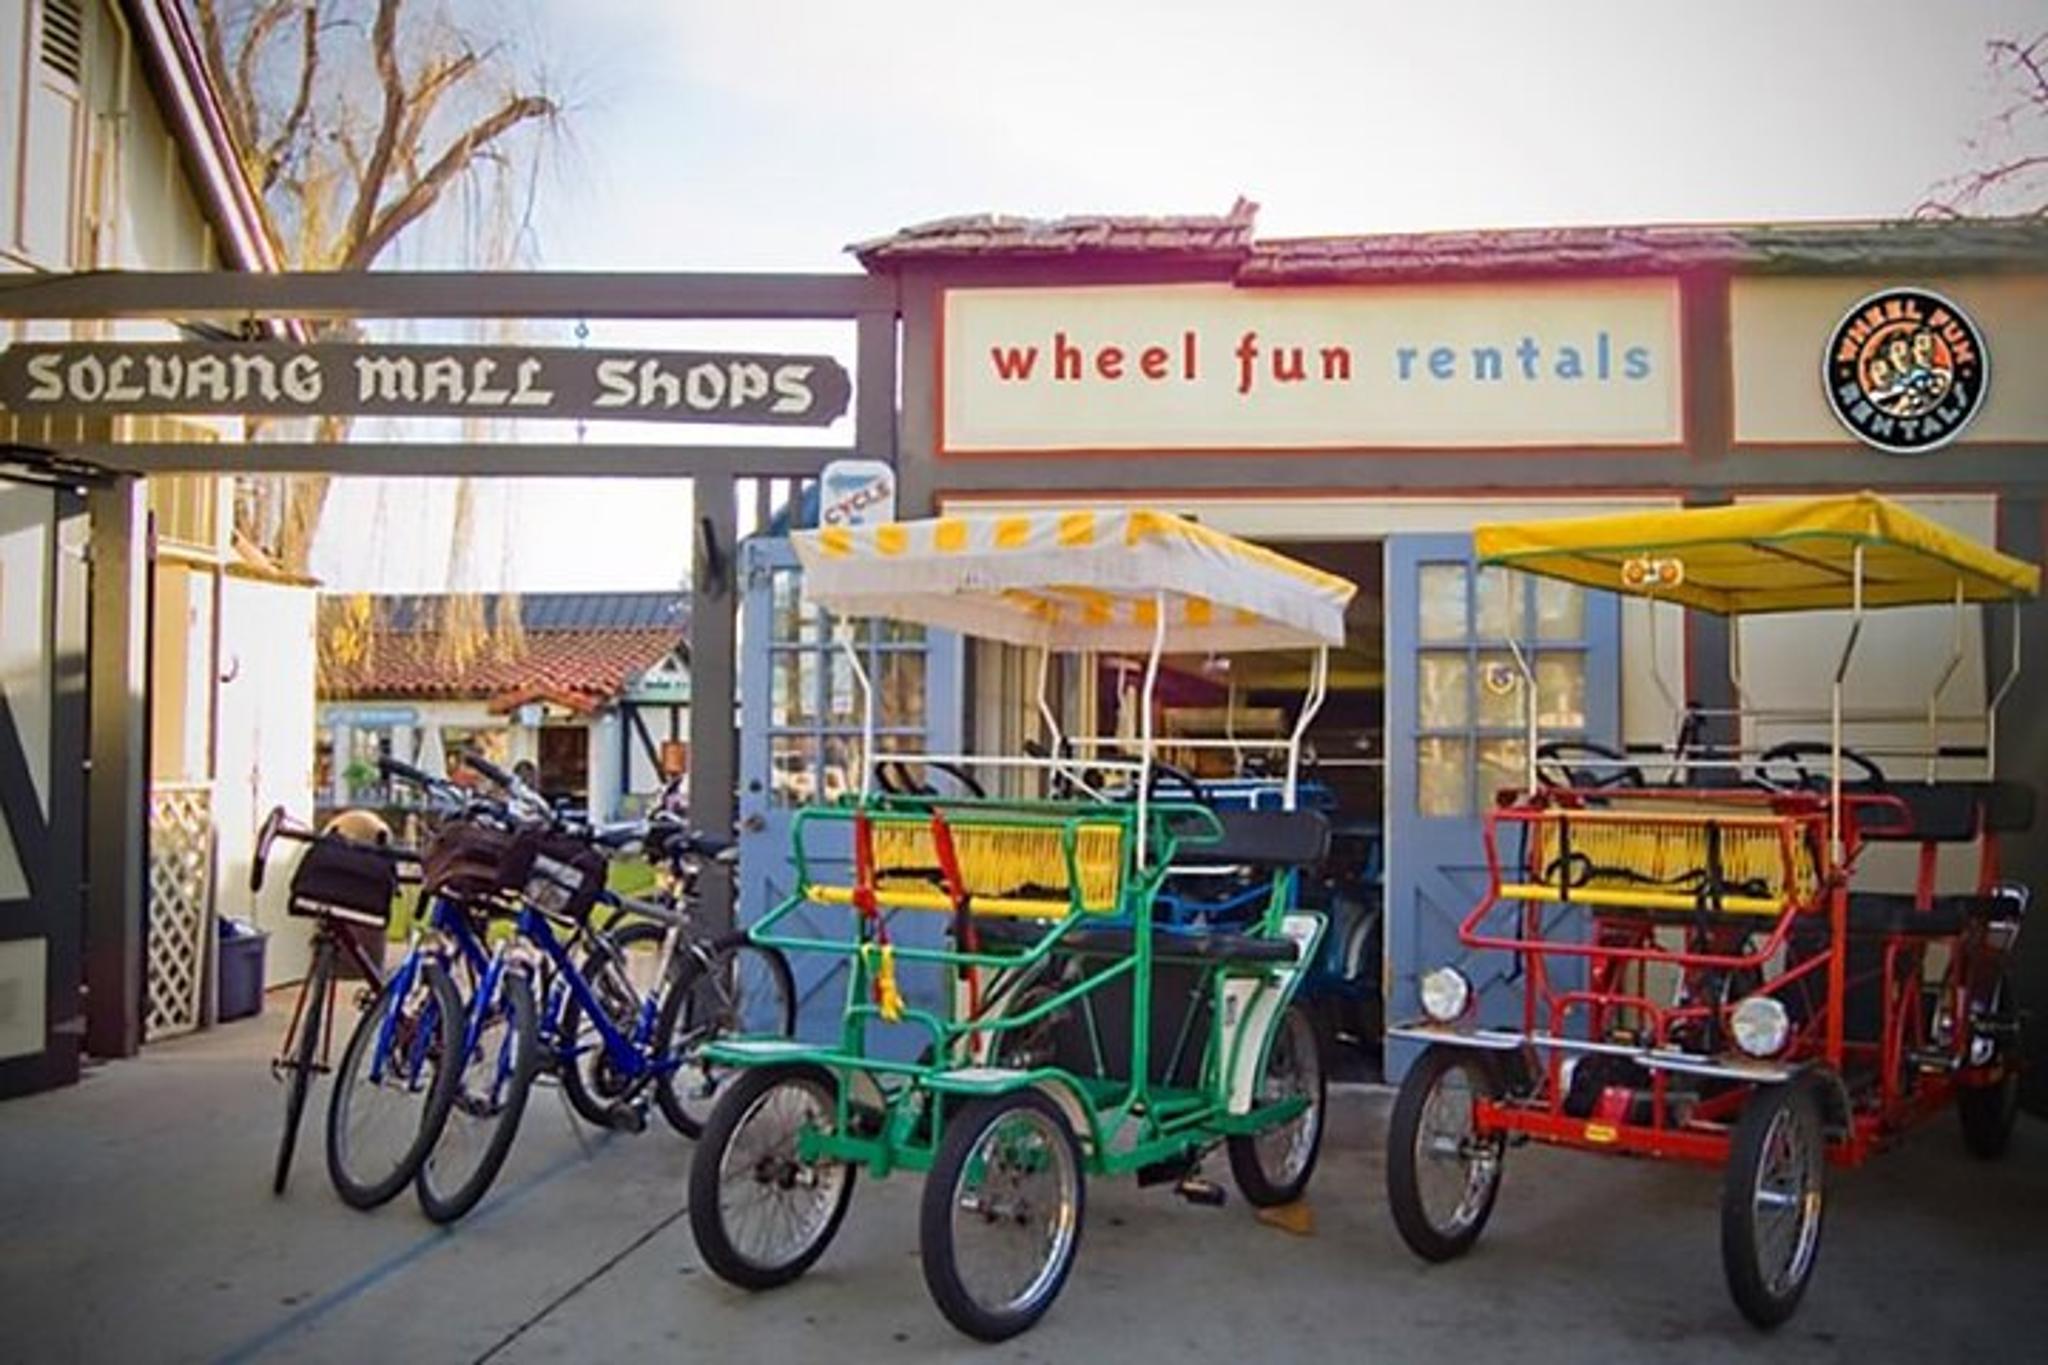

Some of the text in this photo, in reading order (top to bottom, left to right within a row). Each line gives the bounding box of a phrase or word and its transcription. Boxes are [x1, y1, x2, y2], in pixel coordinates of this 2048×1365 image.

[354, 355, 554, 406] MALL
[991, 331, 1653, 395] wheel fun rentals
[1838, 381, 1967, 441] RENTALS
[824, 481, 891, 525] CYCLE
